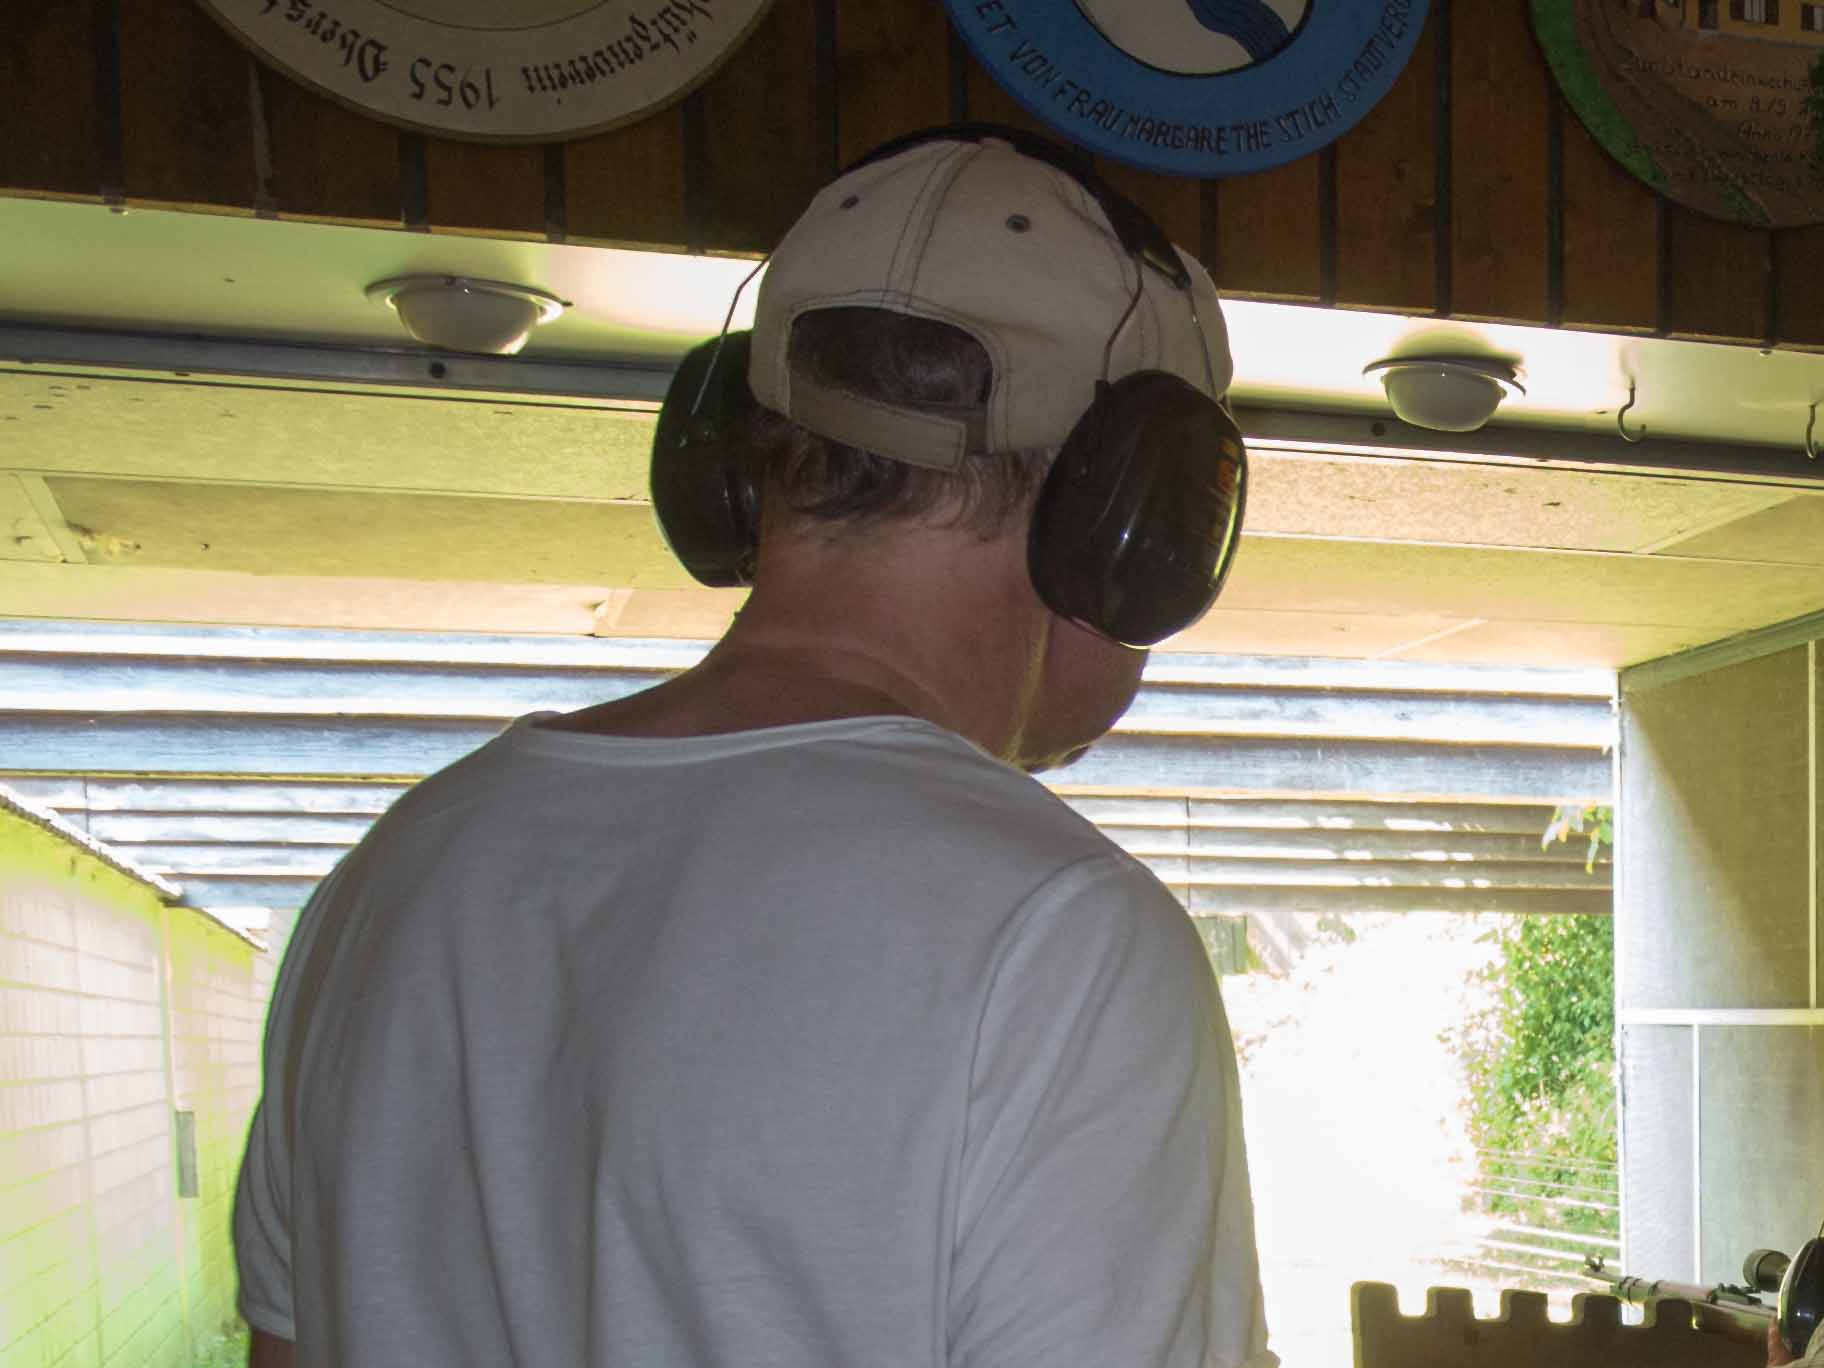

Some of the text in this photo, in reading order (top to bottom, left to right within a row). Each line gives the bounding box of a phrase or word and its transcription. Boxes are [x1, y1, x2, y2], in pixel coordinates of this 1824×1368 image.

[410, 57, 499, 111] 1955
[1008, 40, 1064, 89] VON
[1055, 79, 1124, 131] FRAU
